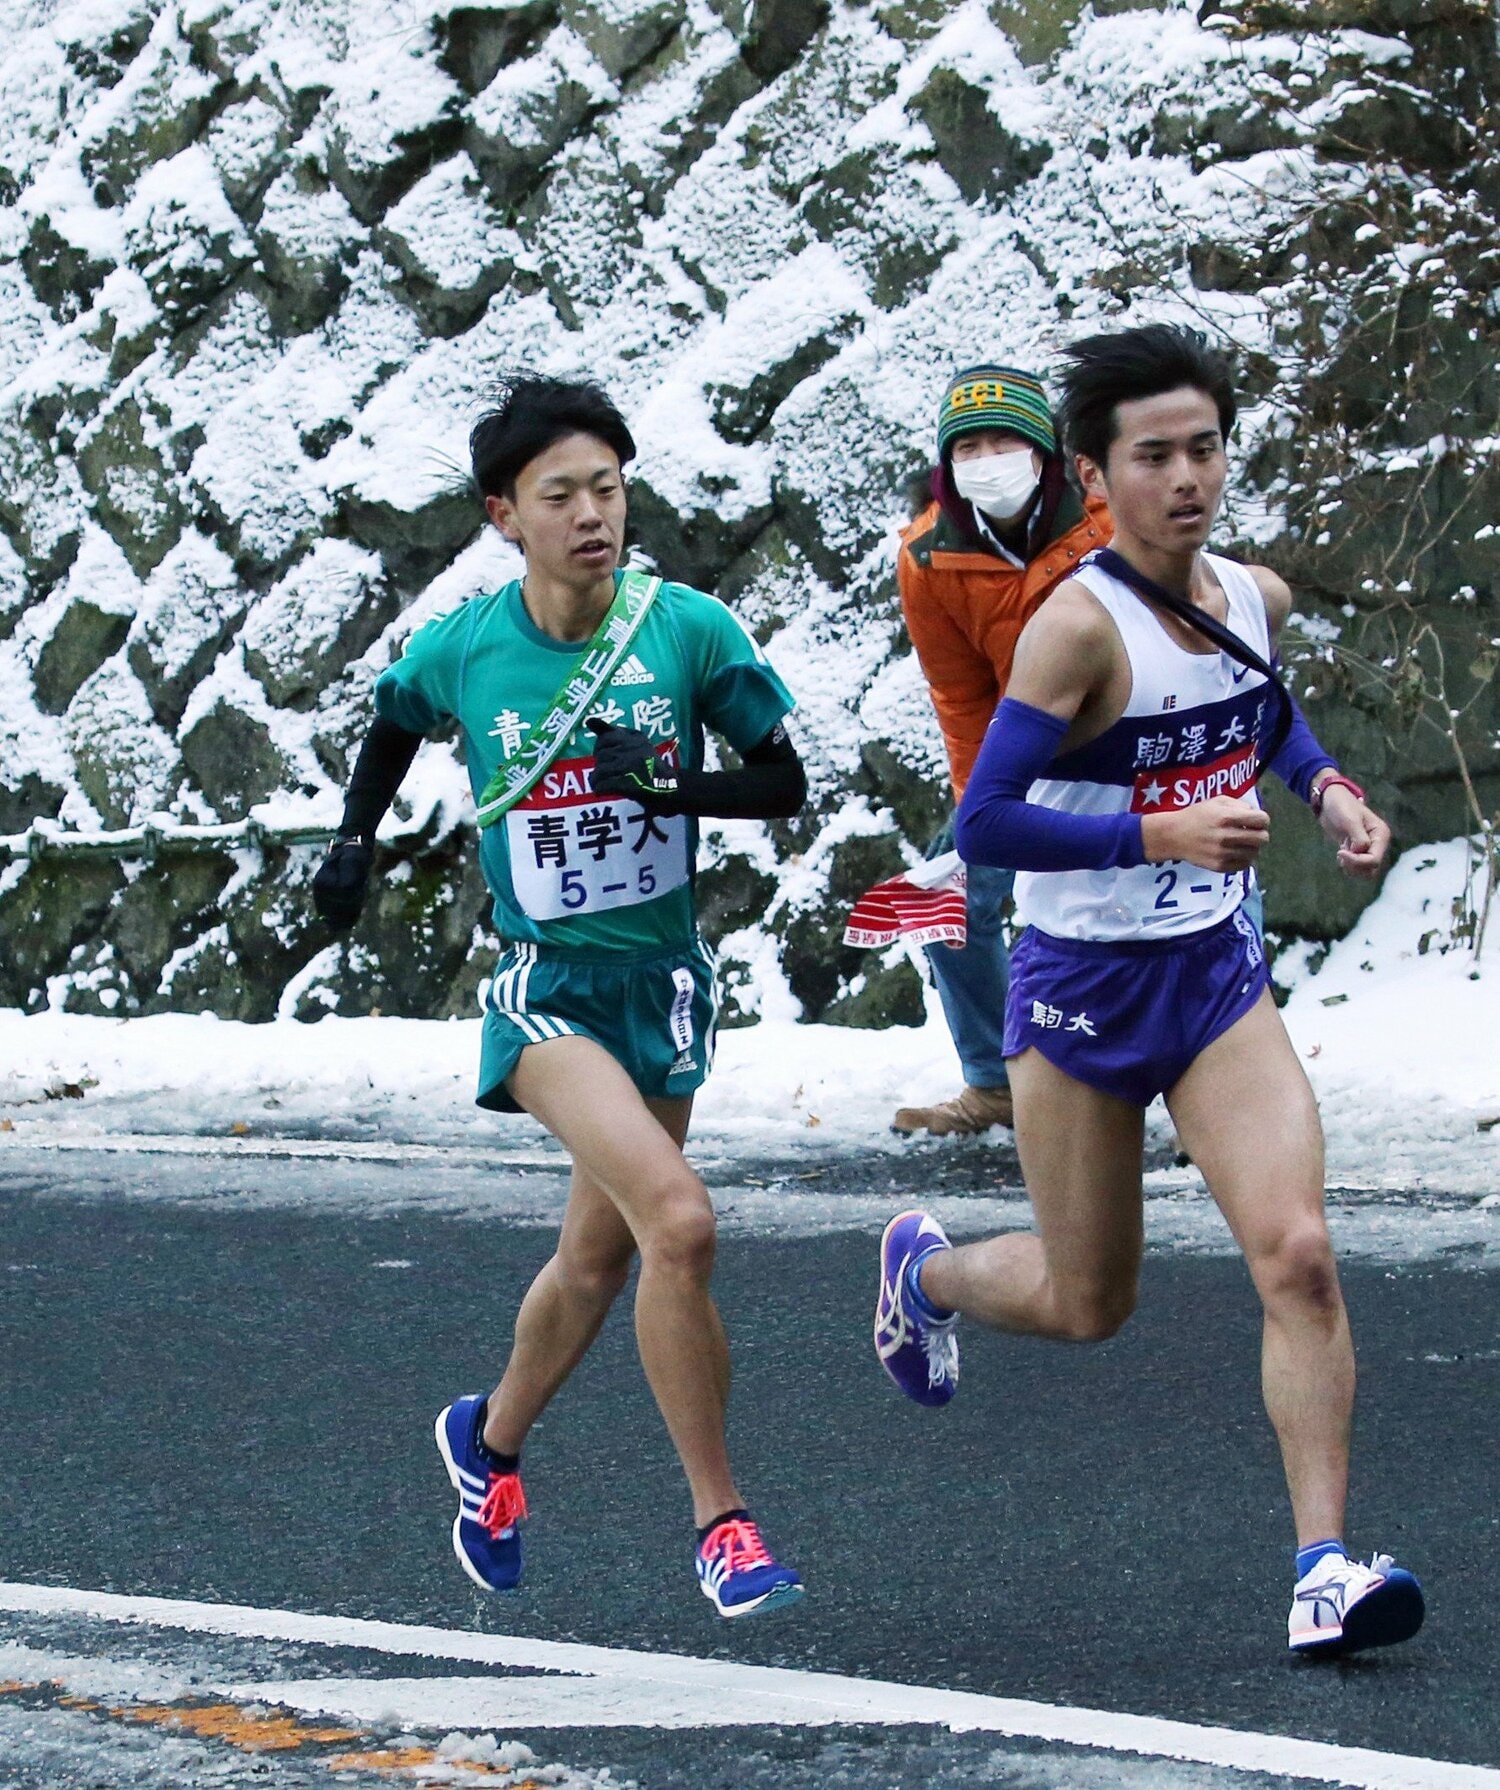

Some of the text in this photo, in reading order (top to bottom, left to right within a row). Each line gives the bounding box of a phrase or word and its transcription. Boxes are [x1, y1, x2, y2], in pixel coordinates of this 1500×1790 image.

[610, 672, 655, 686] adidas
[1173, 755, 1256, 806] SAPPORO
[527, 805, 669, 869] 青学大
[1030, 1000, 1098, 1036] 駒大
